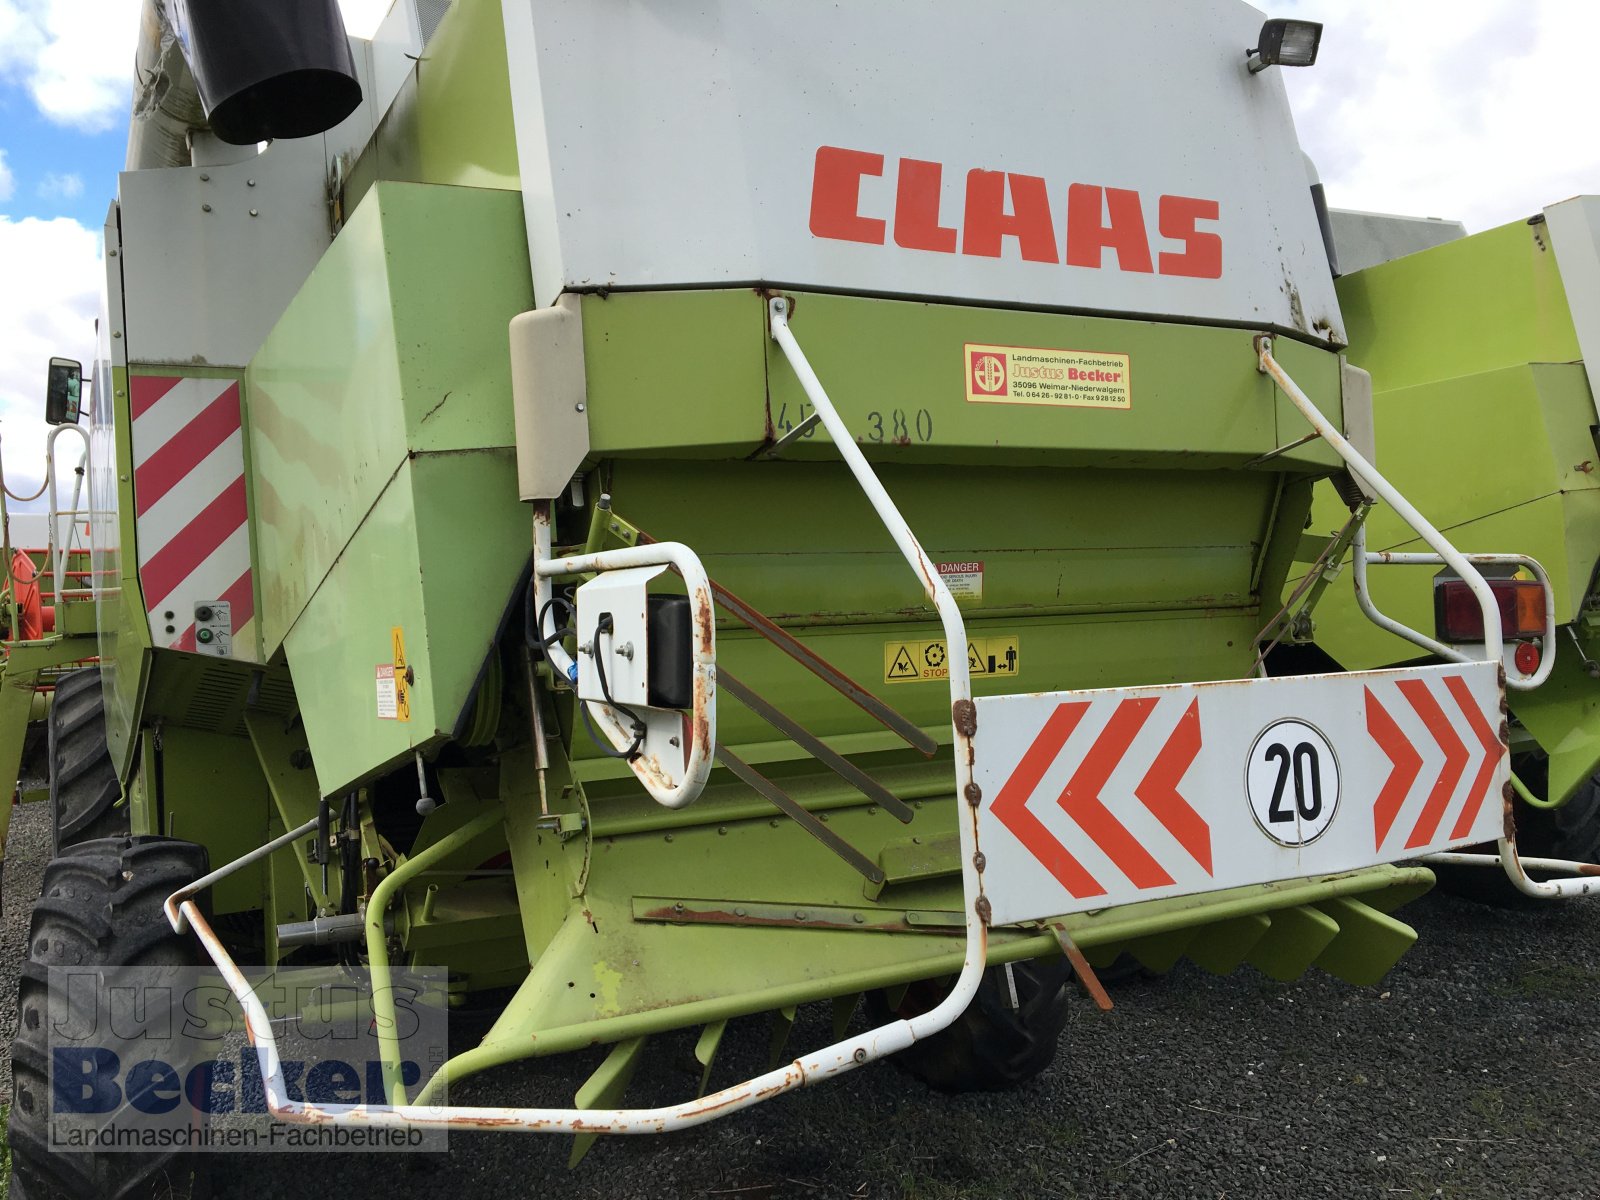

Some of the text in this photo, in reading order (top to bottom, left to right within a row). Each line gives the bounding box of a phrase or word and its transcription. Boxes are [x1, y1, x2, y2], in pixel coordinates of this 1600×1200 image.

[809, 145, 1222, 279] CLAAS
[1012, 354, 1124, 367] Landmaschinen-Fachbetrieb
[1012, 363, 1064, 380] Justus
[1068, 367, 1121, 382] Becker
[1012, 381, 1125, 394] 35096 Weimar-Niederwalgern
[940, 562, 978, 572] DANGER
[923, 668, 948, 677] STOP
[1264, 742, 1322, 823] 20
